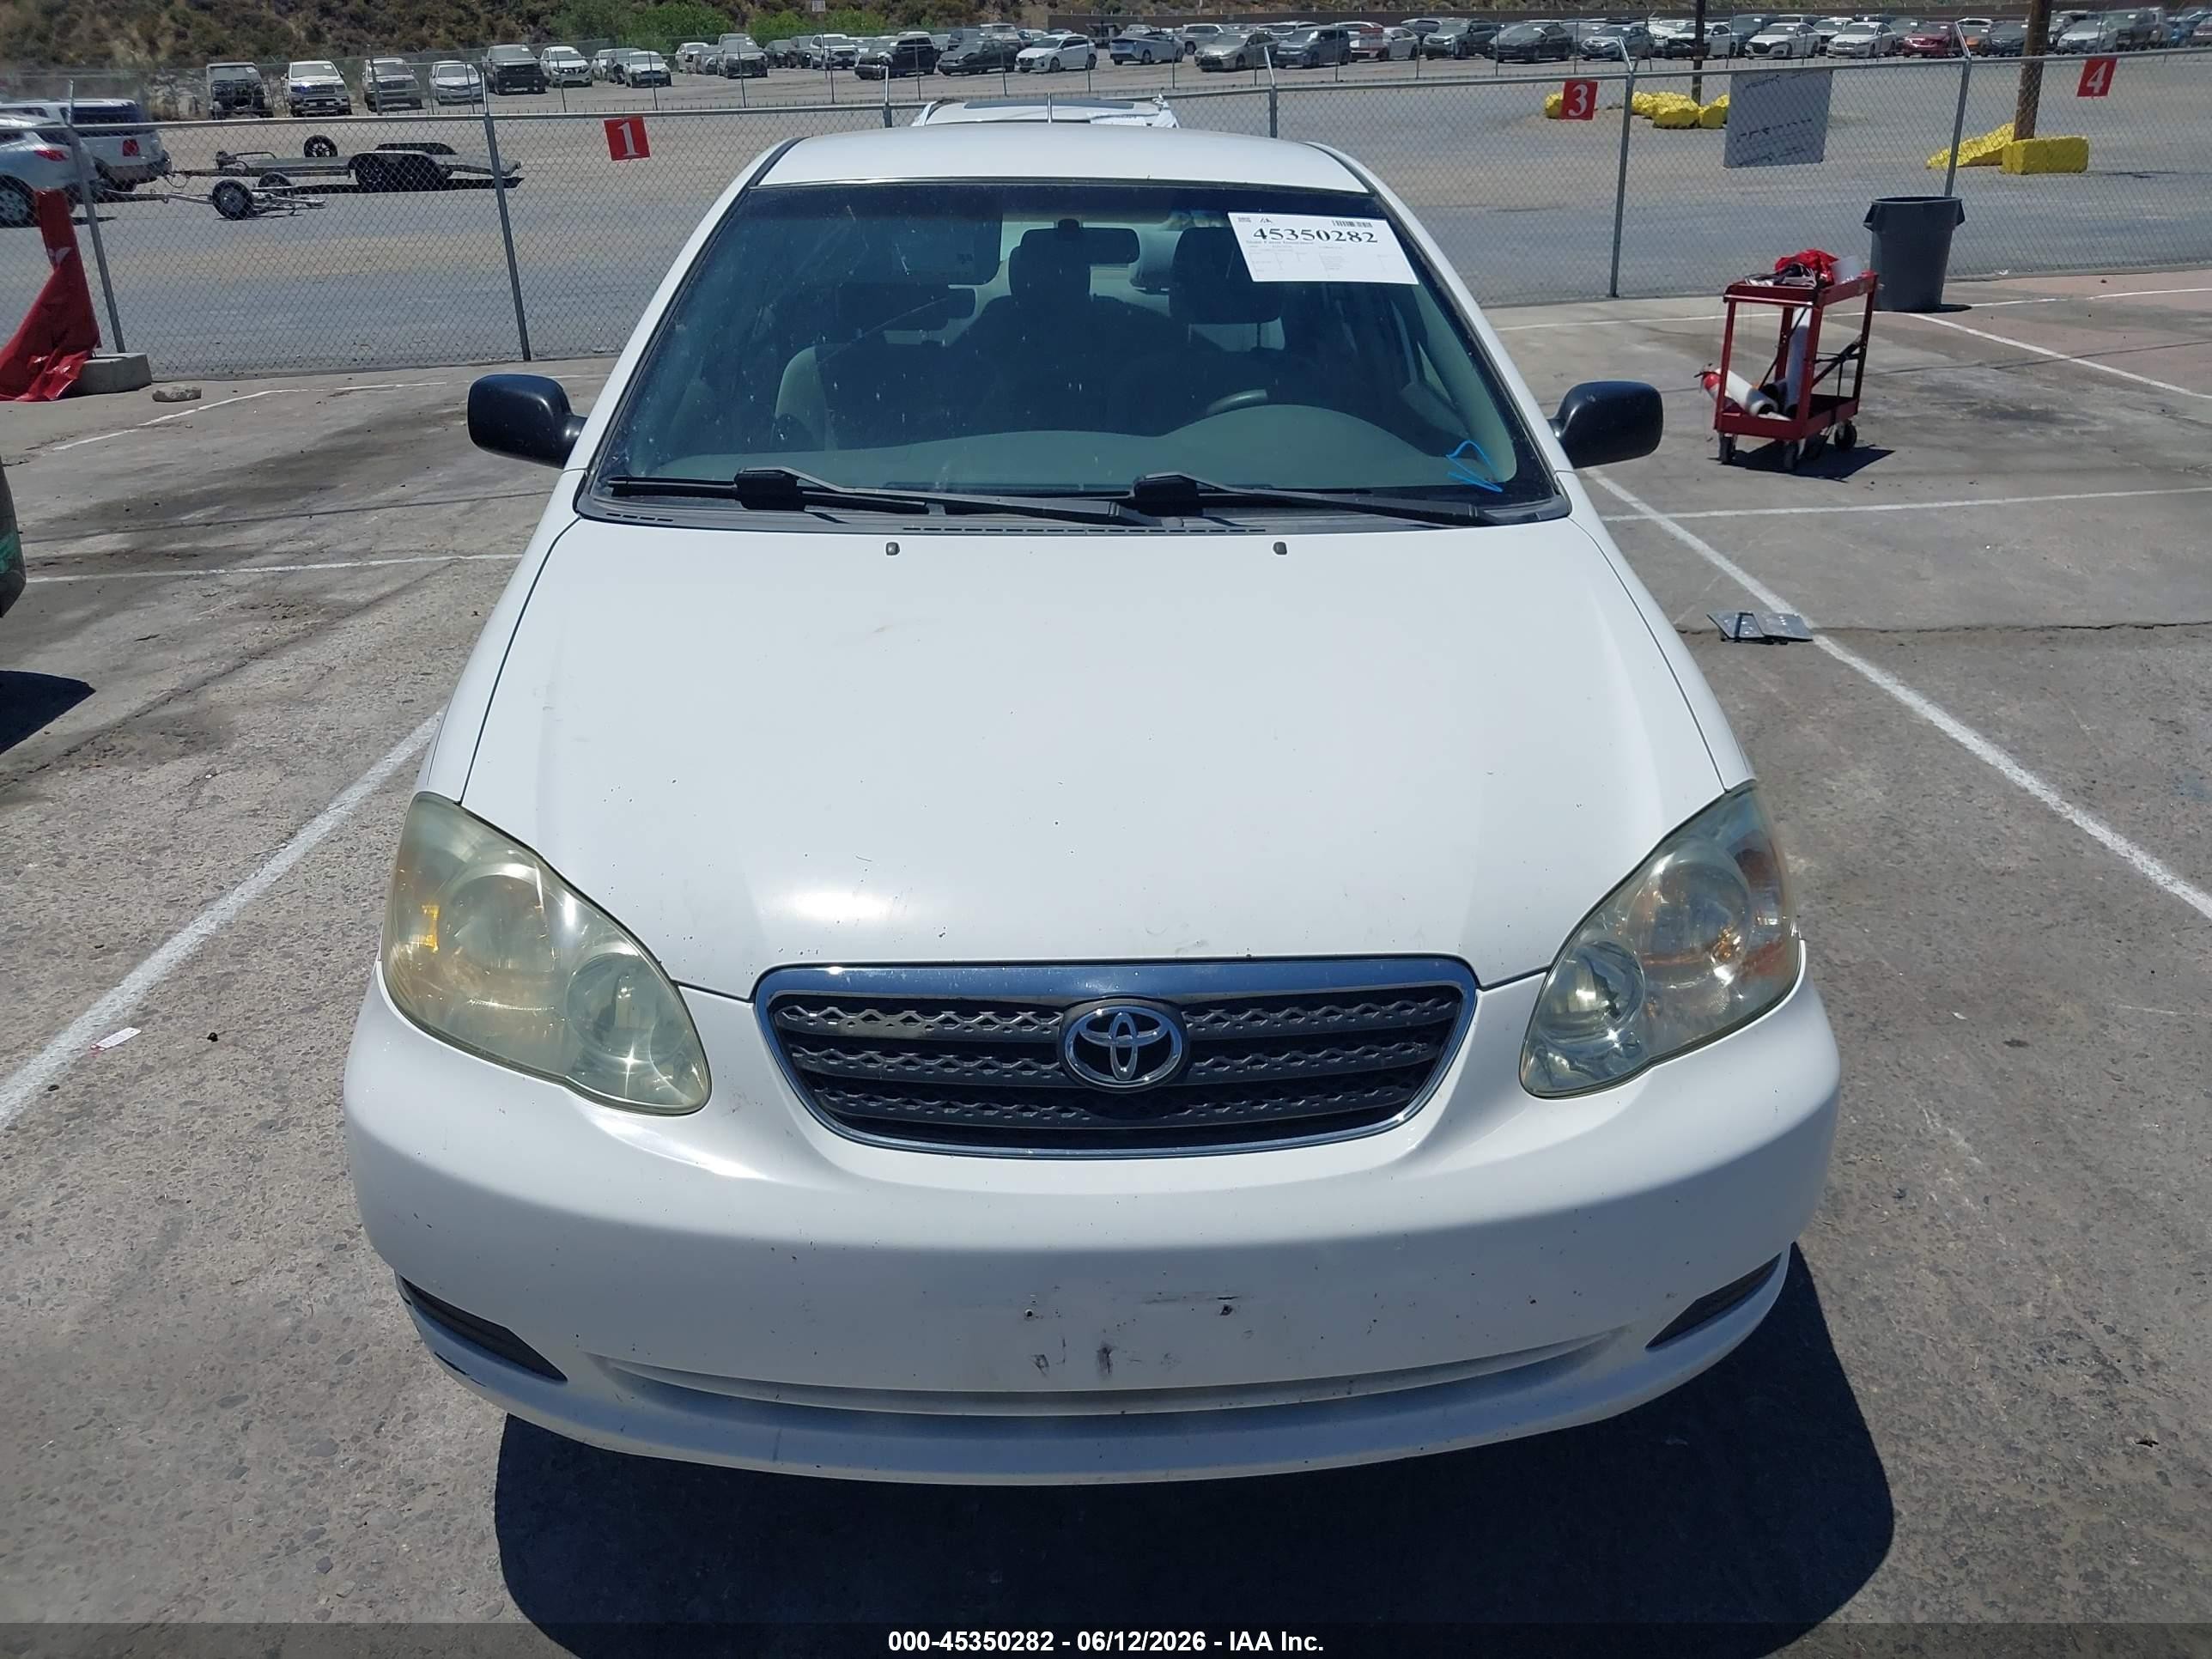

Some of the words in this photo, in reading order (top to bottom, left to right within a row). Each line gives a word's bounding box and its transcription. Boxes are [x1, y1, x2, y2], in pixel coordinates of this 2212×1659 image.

[2087, 61, 2107, 94] 4
[1568, 84, 1588, 117] 3
[617, 121, 641, 156] 1
[1253, 228, 1378, 243] 45350282
